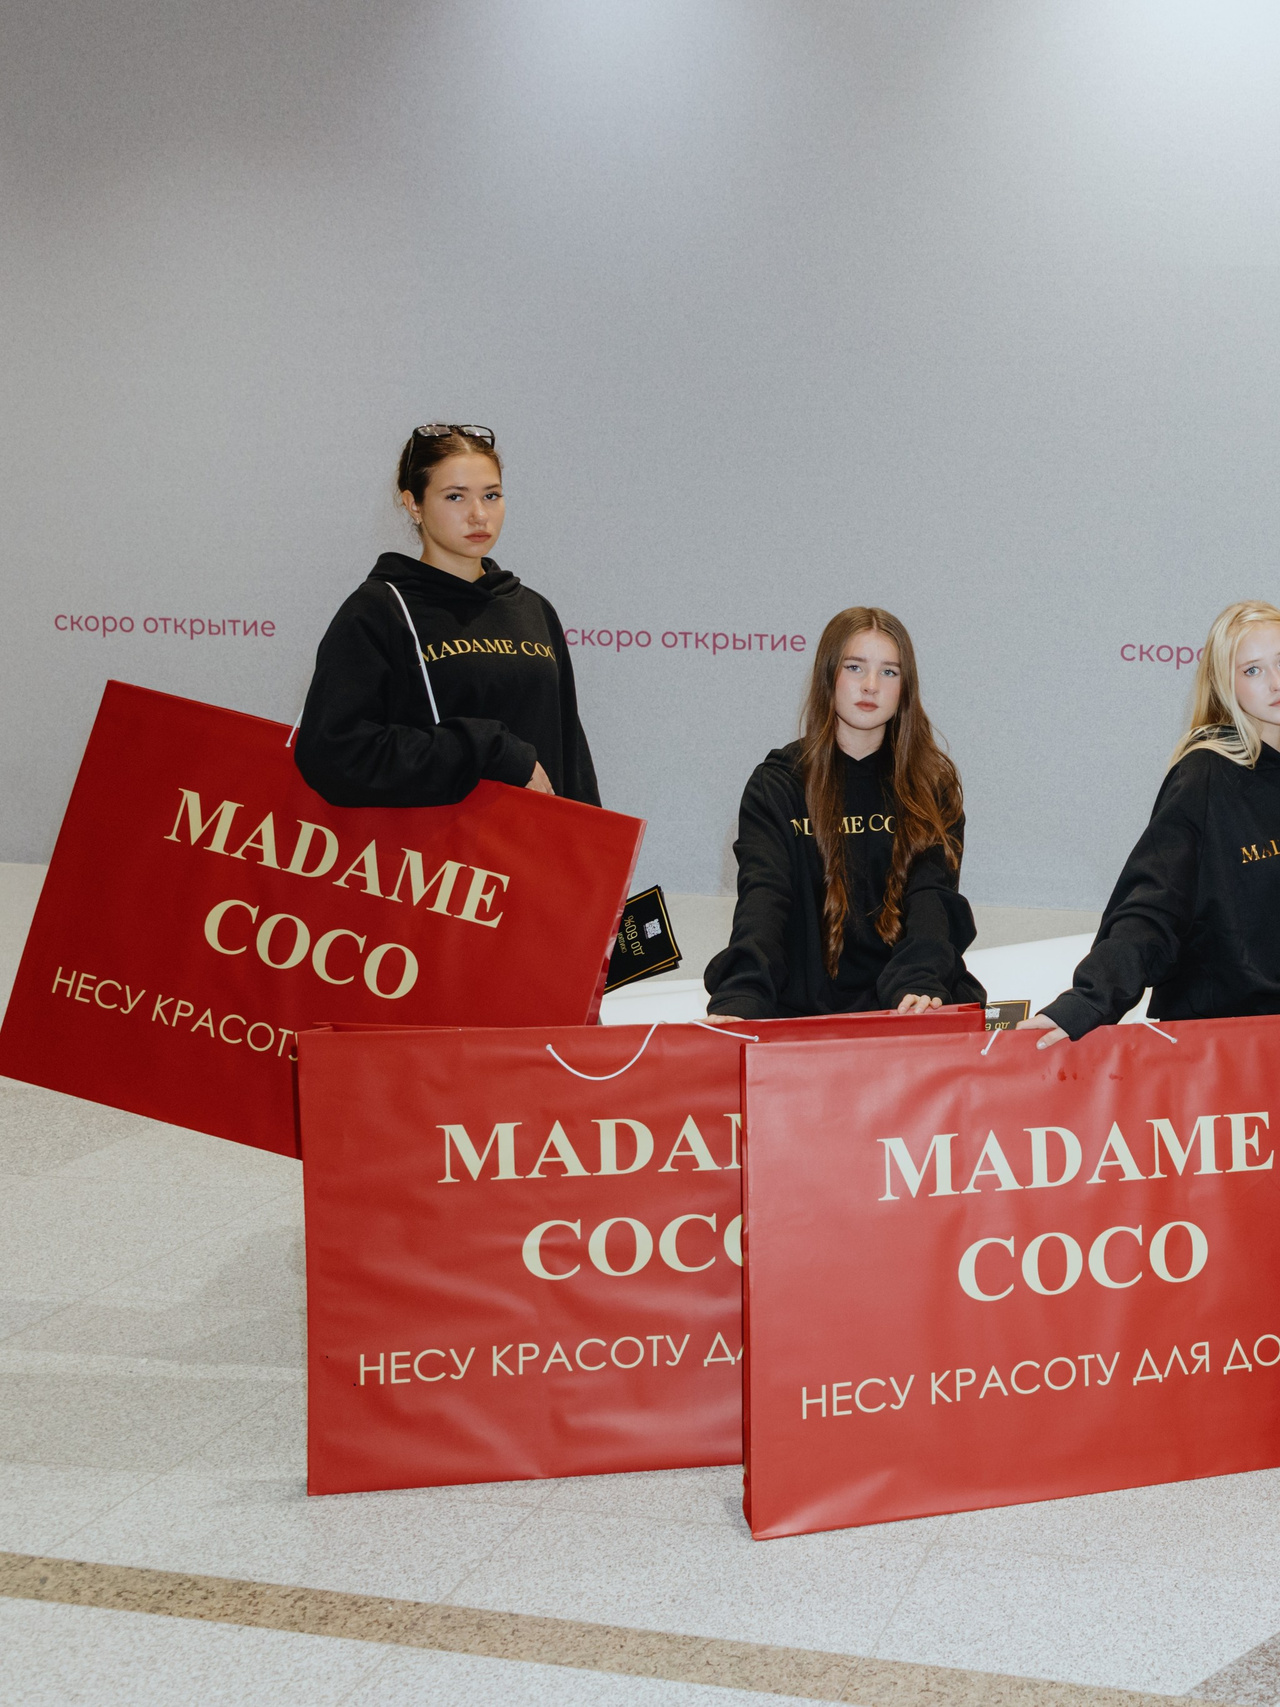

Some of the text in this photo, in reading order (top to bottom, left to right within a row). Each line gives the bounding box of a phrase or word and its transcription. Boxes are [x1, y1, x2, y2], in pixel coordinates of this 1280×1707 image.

[54, 614, 276, 640] скоро открытие
[419, 638, 557, 666] MADAME COC
[564, 628, 807, 655] скоро открытие
[164, 788, 511, 928] MADAME
[203, 899, 419, 1000] COCO
[51, 966, 146, 1014] НЕСУ
[436, 1113, 743, 1183] MADA
[876, 1111, 1275, 1202] MADAME
[957, 1221, 1209, 1302] COCO
[359, 1346, 477, 1386] НЕСУ
[491, 1333, 691, 1377] КРАСОТУ
[801, 1374, 915, 1419] НЕСУ
[930, 1351, 1121, 1405] КРАСОТУ
[1132, 1341, 1211, 1386] ДЛЯ
